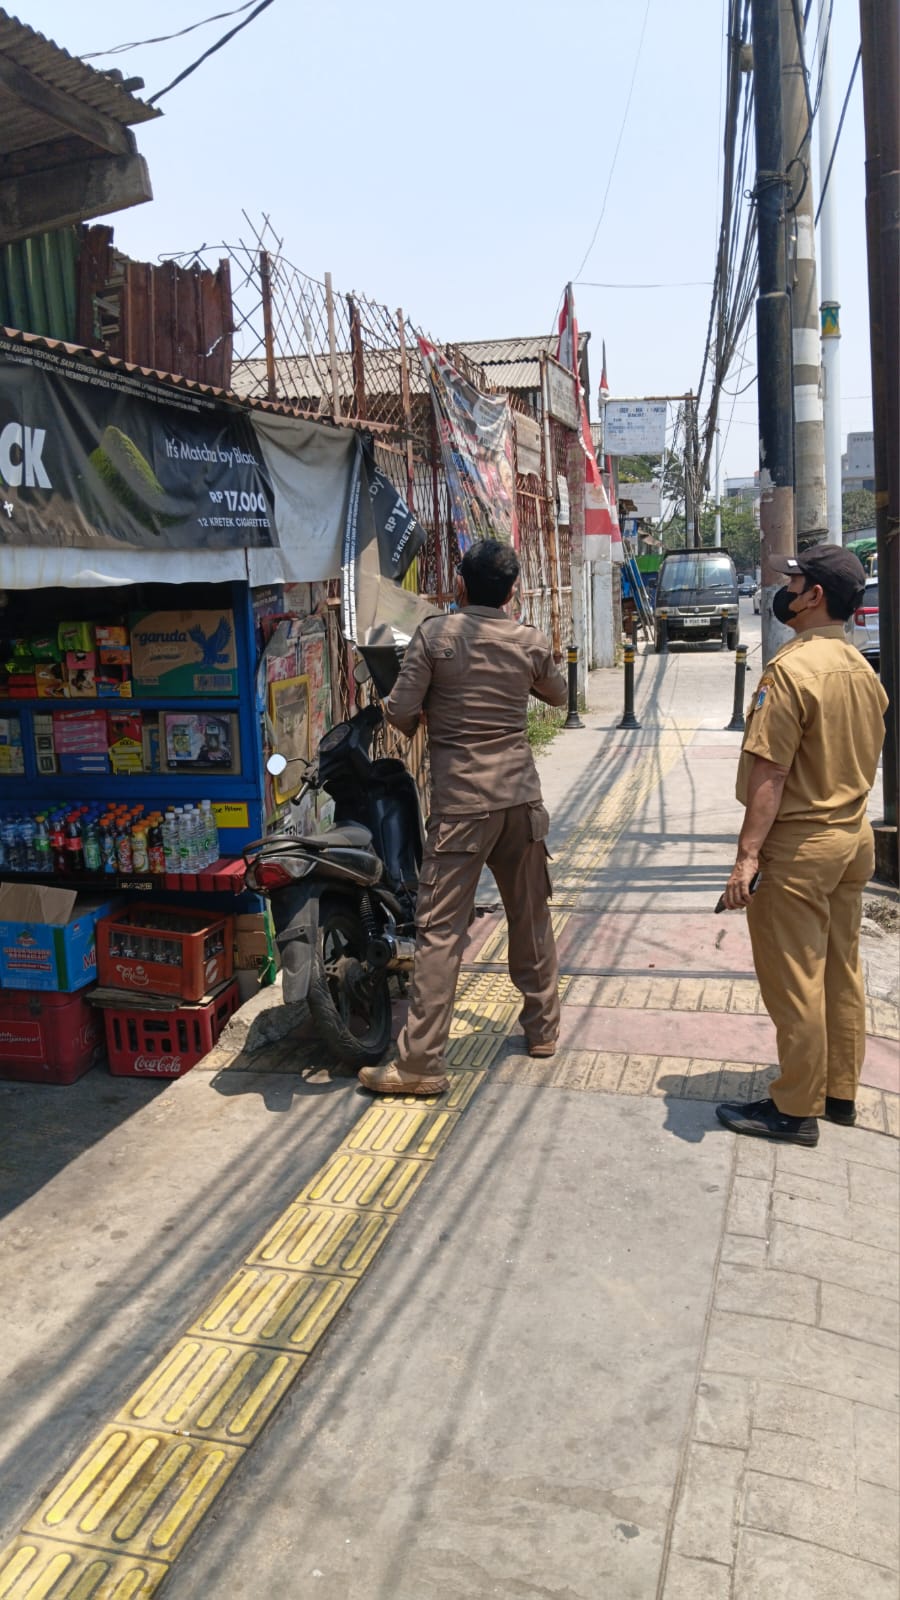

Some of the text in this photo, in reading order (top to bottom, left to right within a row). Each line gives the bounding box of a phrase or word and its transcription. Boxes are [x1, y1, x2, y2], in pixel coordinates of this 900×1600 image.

[165, 438, 179, 458] It's
[180, 441, 218, 463] Matcha
[217, 445, 233, 468] by
[368, 477, 385, 496] by
[209, 490, 267, 512] RP 17.000
[198, 518, 209, 528] 12
[210, 517, 235, 528] KRETEK
[383, 516, 397, 533] RP
[391, 552, 401, 563] 12
[139, 629, 187, 646] garuda
